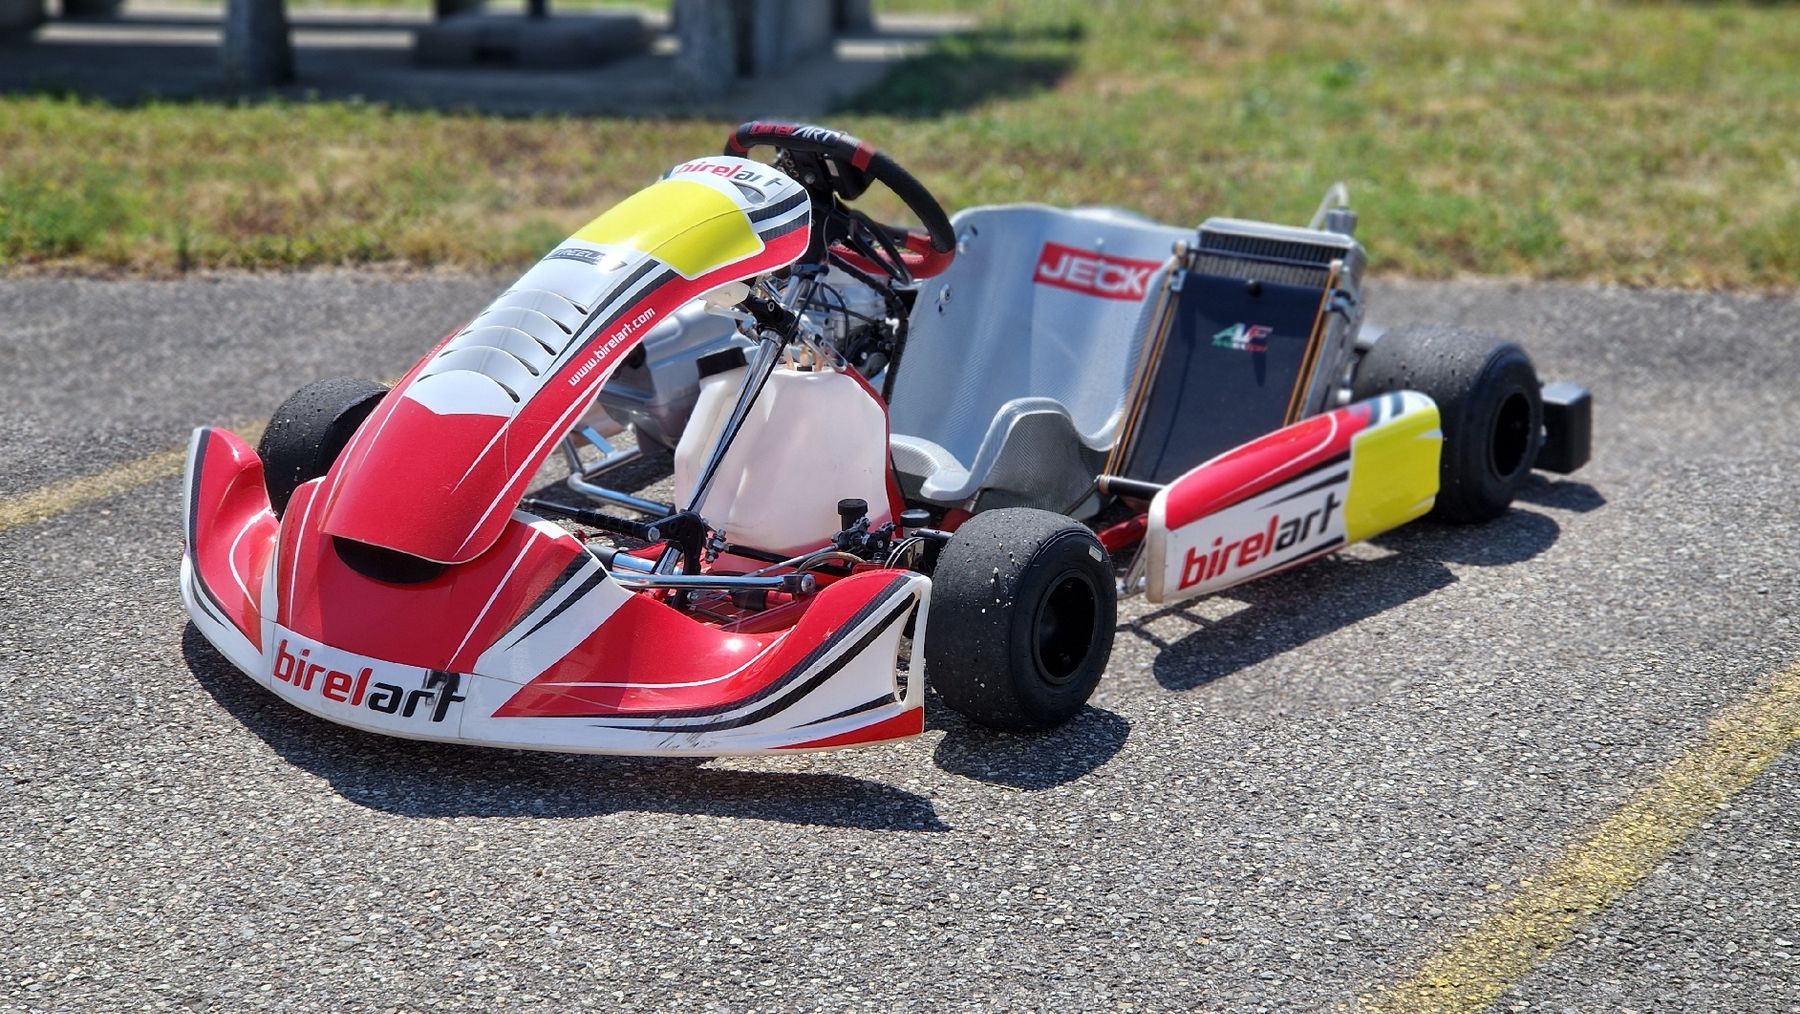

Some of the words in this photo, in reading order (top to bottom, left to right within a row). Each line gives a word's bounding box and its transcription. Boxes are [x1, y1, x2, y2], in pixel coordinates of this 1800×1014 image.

[1039, 253, 1153, 295] JECK
[567, 306, 656, 387] www.birelart.com
[1178, 492, 1342, 591] birelart
[272, 638, 466, 723] birelart
